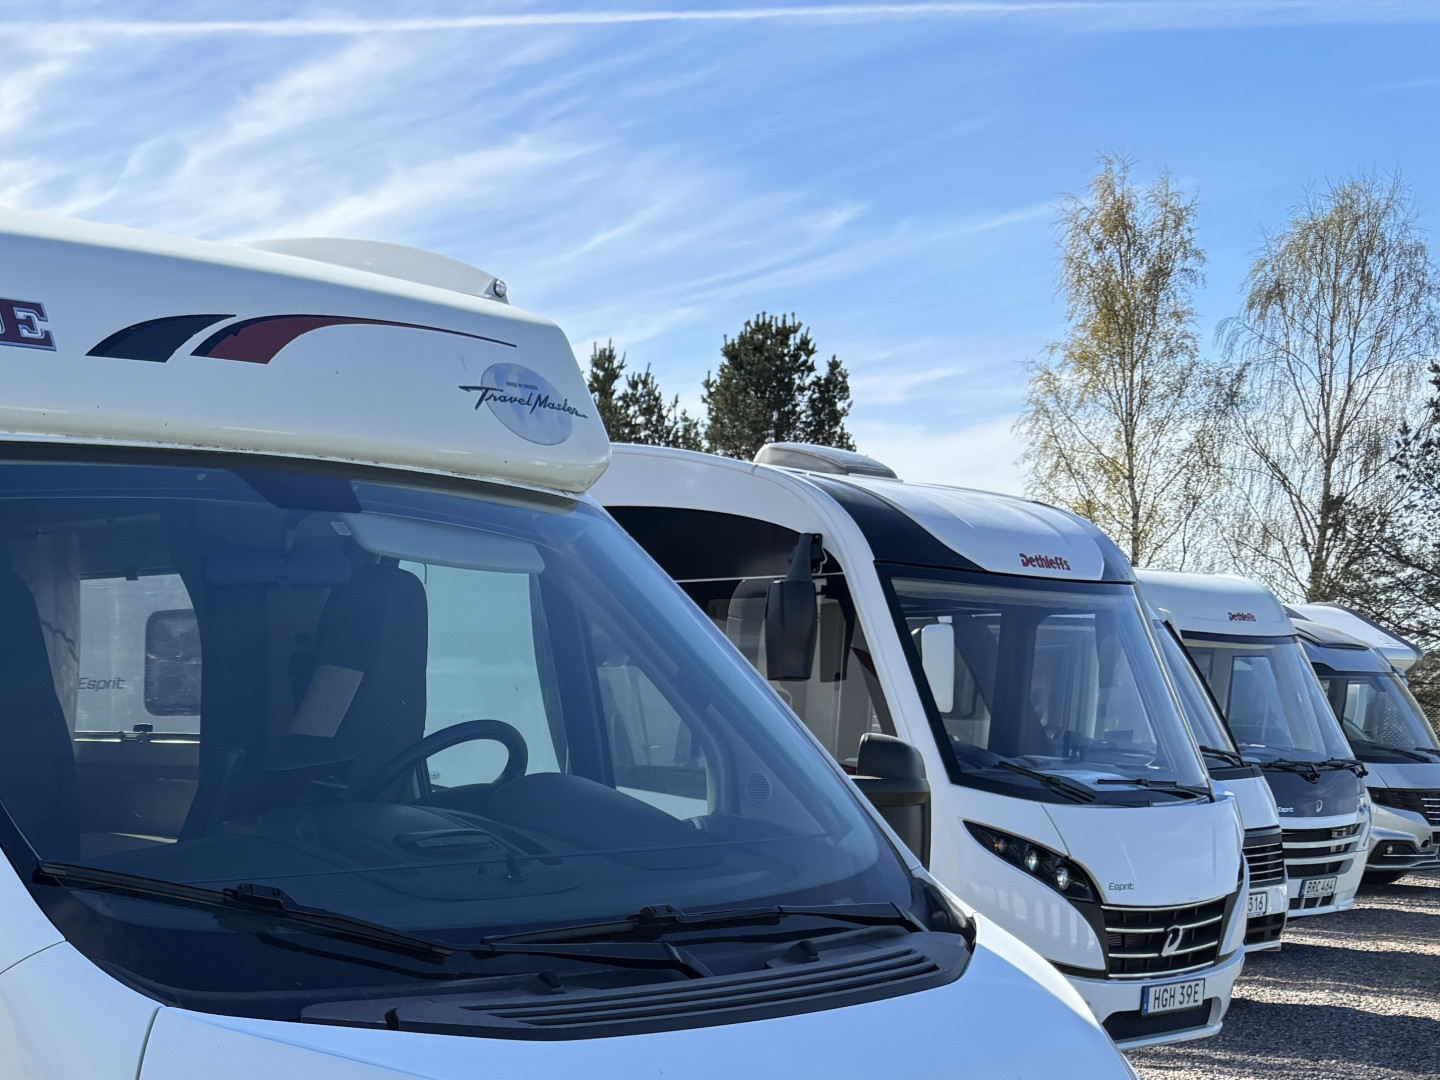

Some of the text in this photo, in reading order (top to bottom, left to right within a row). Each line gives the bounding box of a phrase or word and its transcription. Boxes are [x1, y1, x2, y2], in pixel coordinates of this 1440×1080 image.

[1019, 553, 1071, 571] Dethleffs
[78, 677, 126, 692] Esprit
[1109, 882, 1135, 891] Esprit
[1248, 896, 1264, 911] 316
[1153, 983, 1200, 1010] HGH 39E
